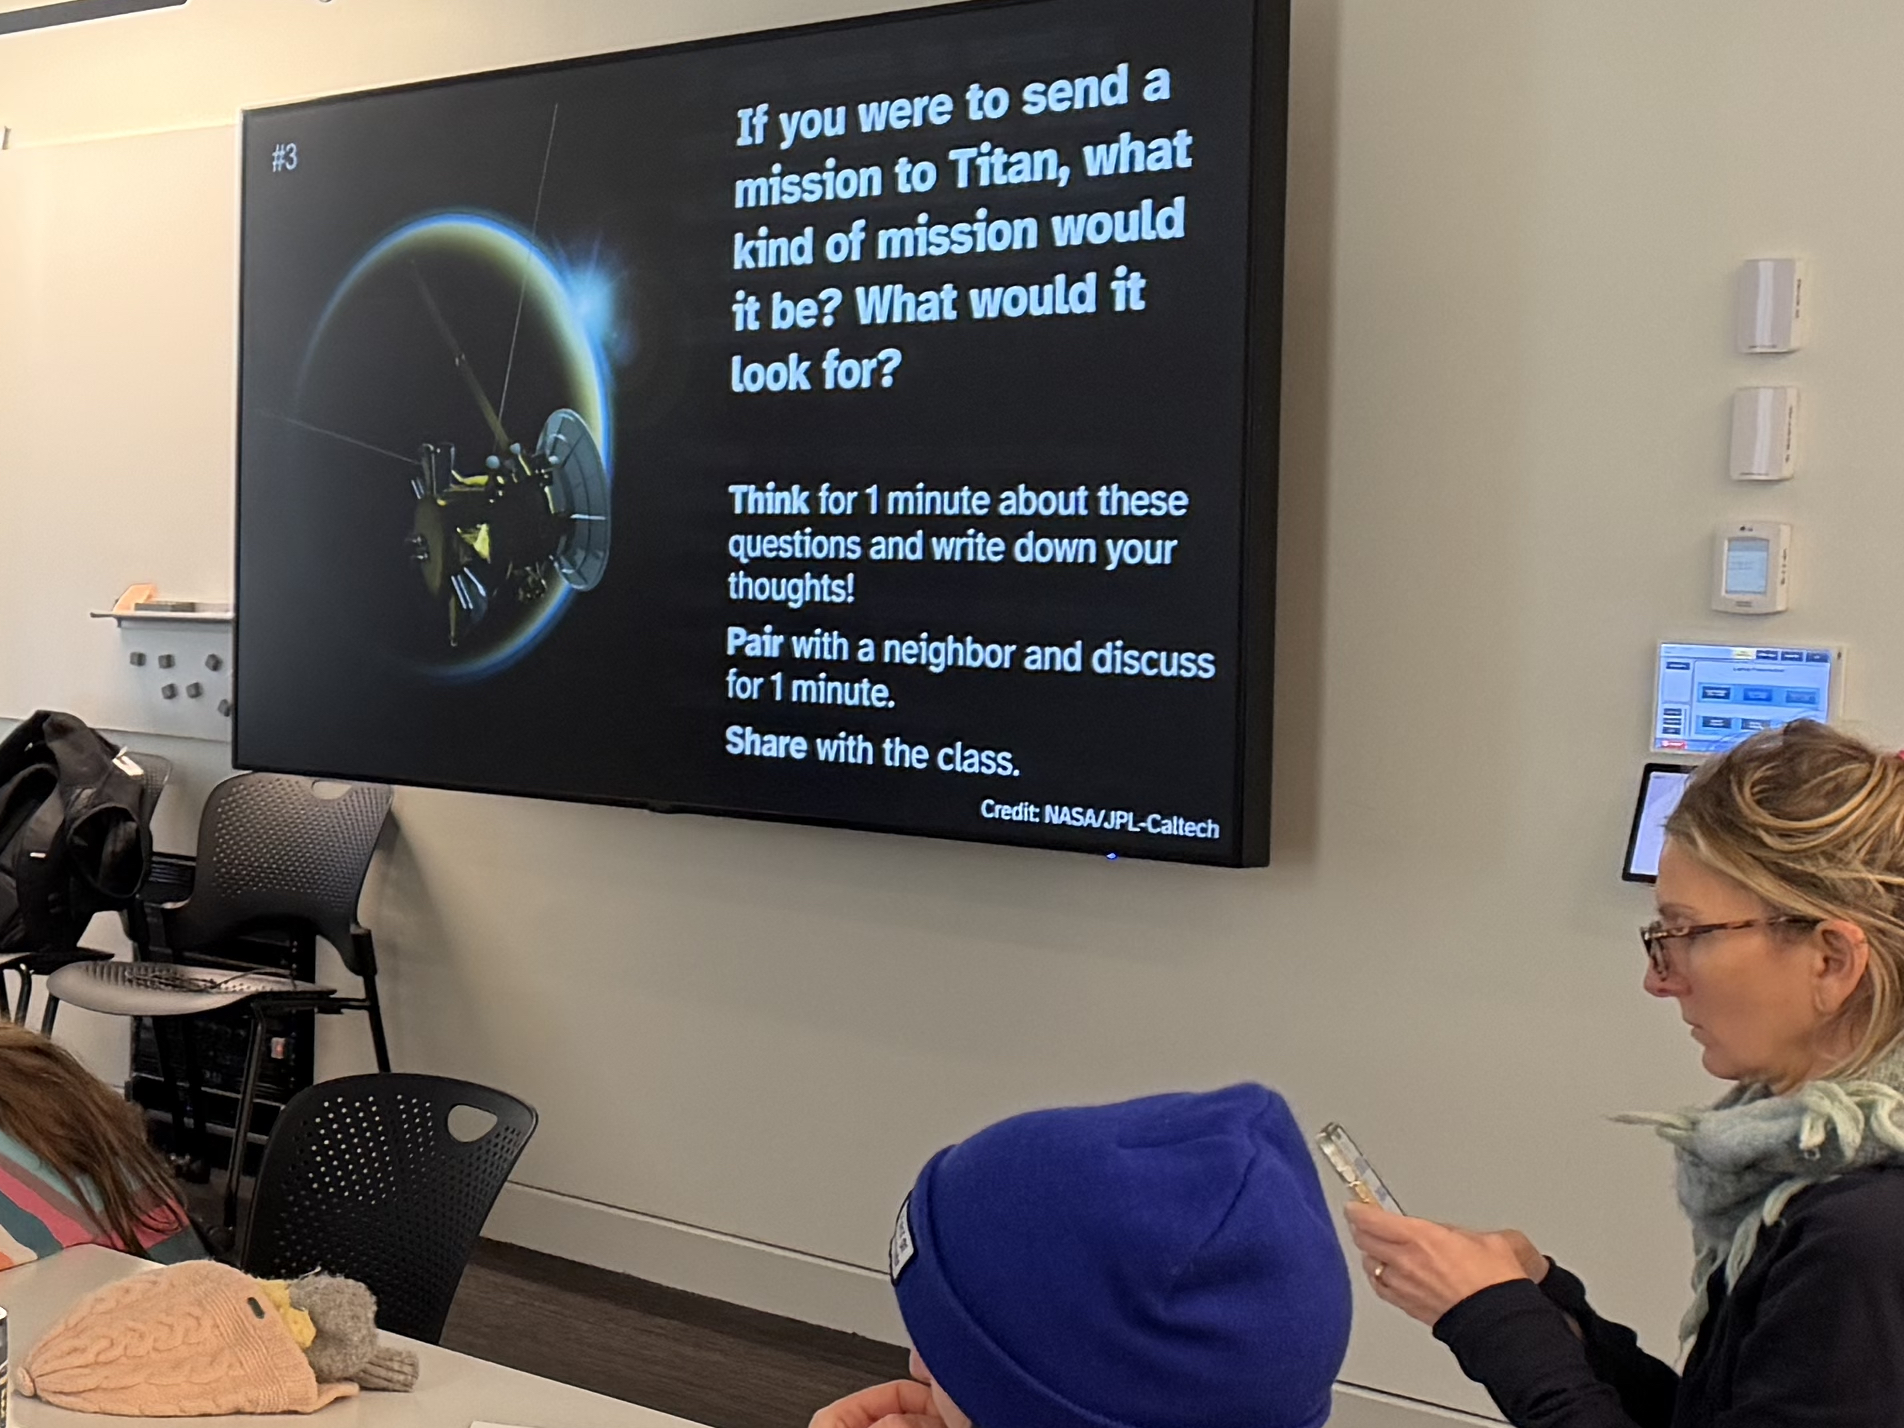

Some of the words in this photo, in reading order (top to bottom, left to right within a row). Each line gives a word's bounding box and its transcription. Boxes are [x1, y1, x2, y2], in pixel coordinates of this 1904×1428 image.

[737, 103, 768, 146] If
[779, 106, 845, 149] you
[858, 94, 953, 132] were
[966, 84, 1009, 120] to
[1023, 63, 1128, 114] send
[1143, 68, 1170, 101] a
[272, 143, 297, 172] #3
[735, 158, 881, 208] mission
[895, 157, 936, 193] to
[949, 142, 1070, 188] Titan,
[1083, 129, 1192, 176] what
[734, 226, 813, 269] kind
[826, 219, 866, 262] of
[878, 208, 1037, 259] mission
[1051, 196, 1185, 246] would
[732, 290, 760, 331] it
[772, 288, 842, 329] be?
[855, 284, 957, 324] What
[969, 272, 1096, 318] would
[1111, 265, 1146, 311] it
[732, 353, 811, 392] look
[822, 348, 902, 389] for?
[728, 482, 810, 514] Think
[818, 483, 858, 514] for
[865, 484, 877, 514] 1
[888, 482, 990, 515] minute
[999, 484, 1088, 515] about
[1097, 483, 1189, 516] these
[729, 527, 862, 563] questions
[870, 530, 923, 560] and
[932, 529, 1005, 562] write
[1014, 531, 1096, 563] down
[1106, 539, 1178, 570] your
[728, 571, 854, 608] thoughts!
[727, 625, 784, 657] Pair
[792, 628, 848, 660] with
[858, 639, 874, 661] a
[884, 632, 1017, 673] neighbor
[1024, 640, 1082, 671] and
[1092, 640, 1215, 678] discuss
[726, 668, 764, 699] for
[771, 672, 782, 700] 1
[792, 673, 895, 708] minute.
[726, 725, 808, 759] Share
[816, 732, 873, 764] with
[883, 737, 929, 769] the
[937, 742, 1019, 776] class.
[981, 799, 1040, 822] Credit:
[1045, 805, 1219, 838] NASA/JPL-Caltech
